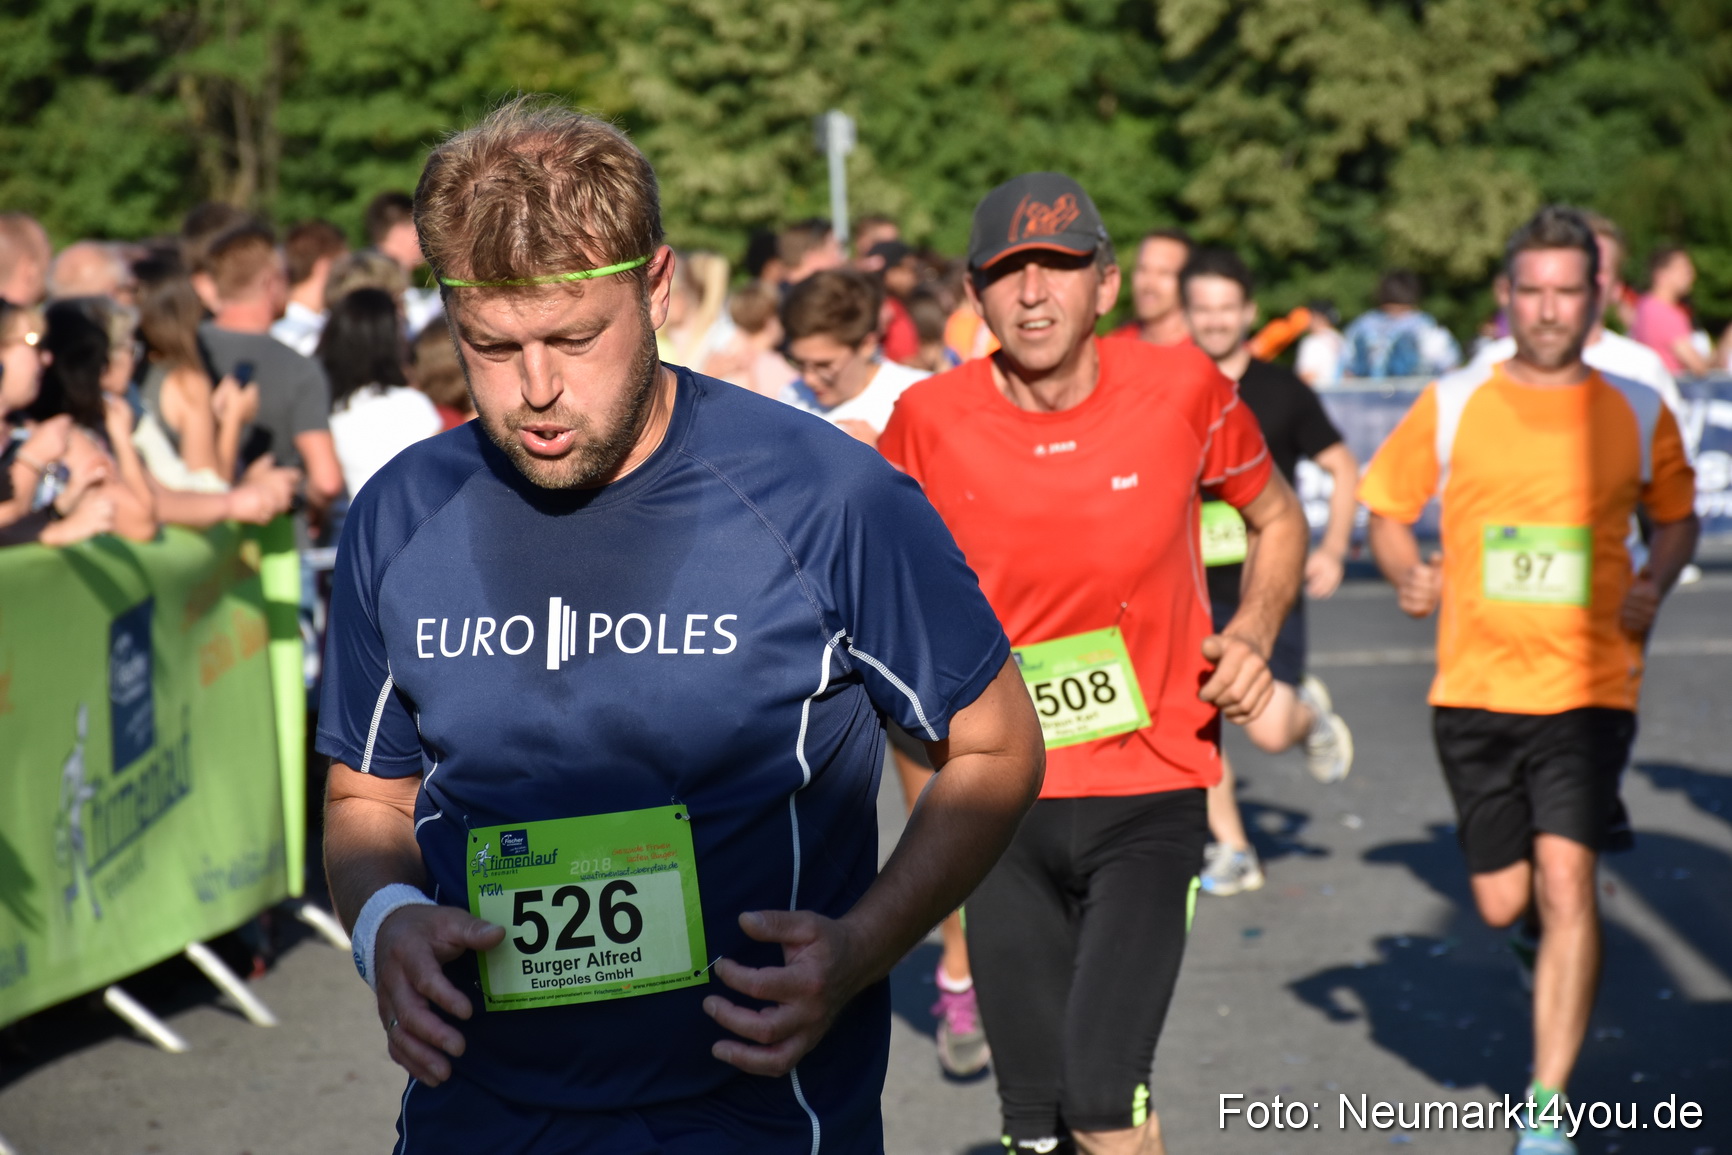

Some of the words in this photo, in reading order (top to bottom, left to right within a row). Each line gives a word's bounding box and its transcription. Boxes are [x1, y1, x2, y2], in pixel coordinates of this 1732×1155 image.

[1513, 552, 1554, 582] 97
[416, 614, 535, 659] EURO
[588, 612, 738, 655] POLES
[1034, 670, 1117, 717] 508
[490, 848, 559, 871] firmenlauf
[491, 869, 518, 877] neumarkt
[570, 857, 612, 875] 2018
[512, 879, 644, 955] 526
[521, 956, 581, 976] Burger
[586, 947, 642, 968] Alfred
[531, 973, 591, 990] Europoles
[595, 967, 634, 982] GmbH
